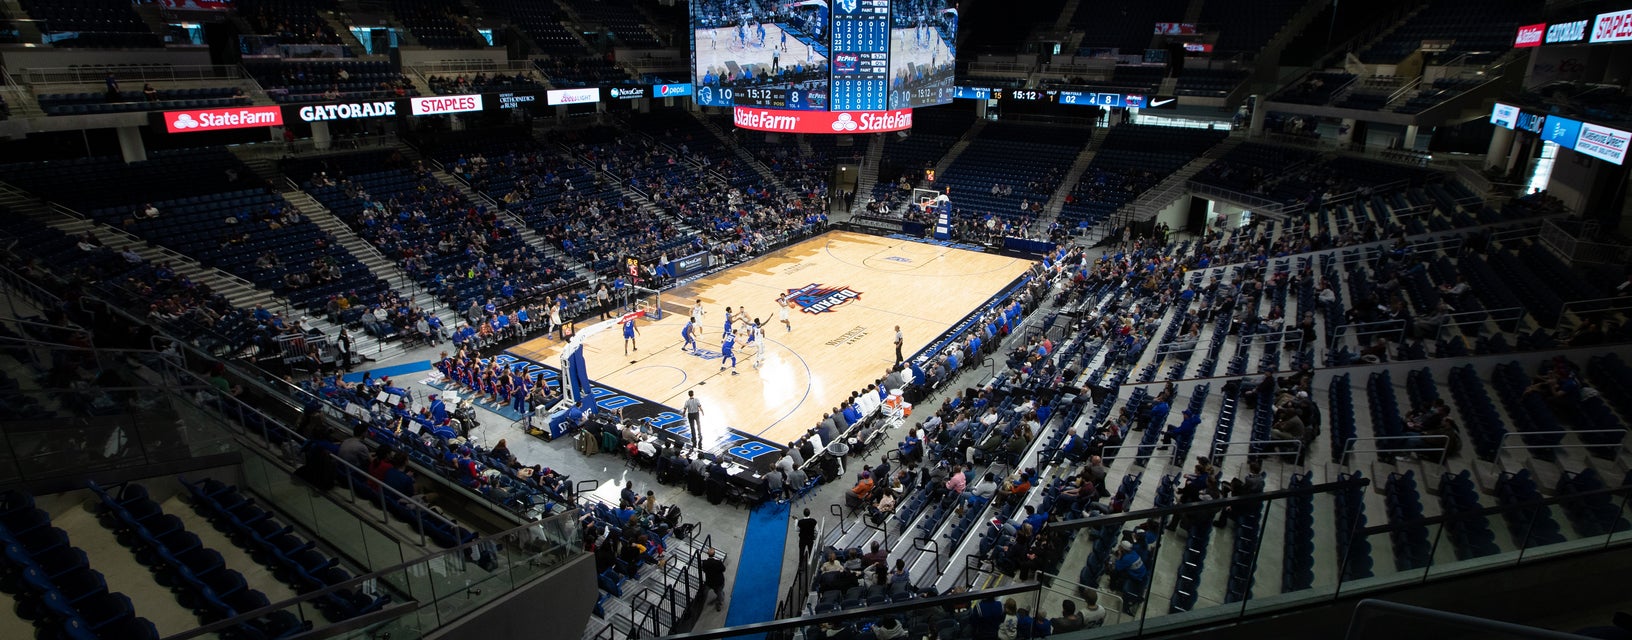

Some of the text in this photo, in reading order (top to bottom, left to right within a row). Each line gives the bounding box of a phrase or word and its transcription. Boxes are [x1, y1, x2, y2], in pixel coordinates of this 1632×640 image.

[670, 87, 685, 95] pepsi
[719, 89, 732, 99] 10
[747, 89, 771, 99] 15:12
[902, 91, 910, 102] 10
[939, 88, 942, 98] 8
[1013, 90, 1036, 100] 15:12
[792, 92, 799, 103] 8
[421, 97, 476, 113] STAPLES
[299, 101, 396, 121] GATORADE
[803, 289, 857, 314] DEPAUL
[825, 325, 864, 346] WINTRUST
[847, 332, 869, 345] ARENA
